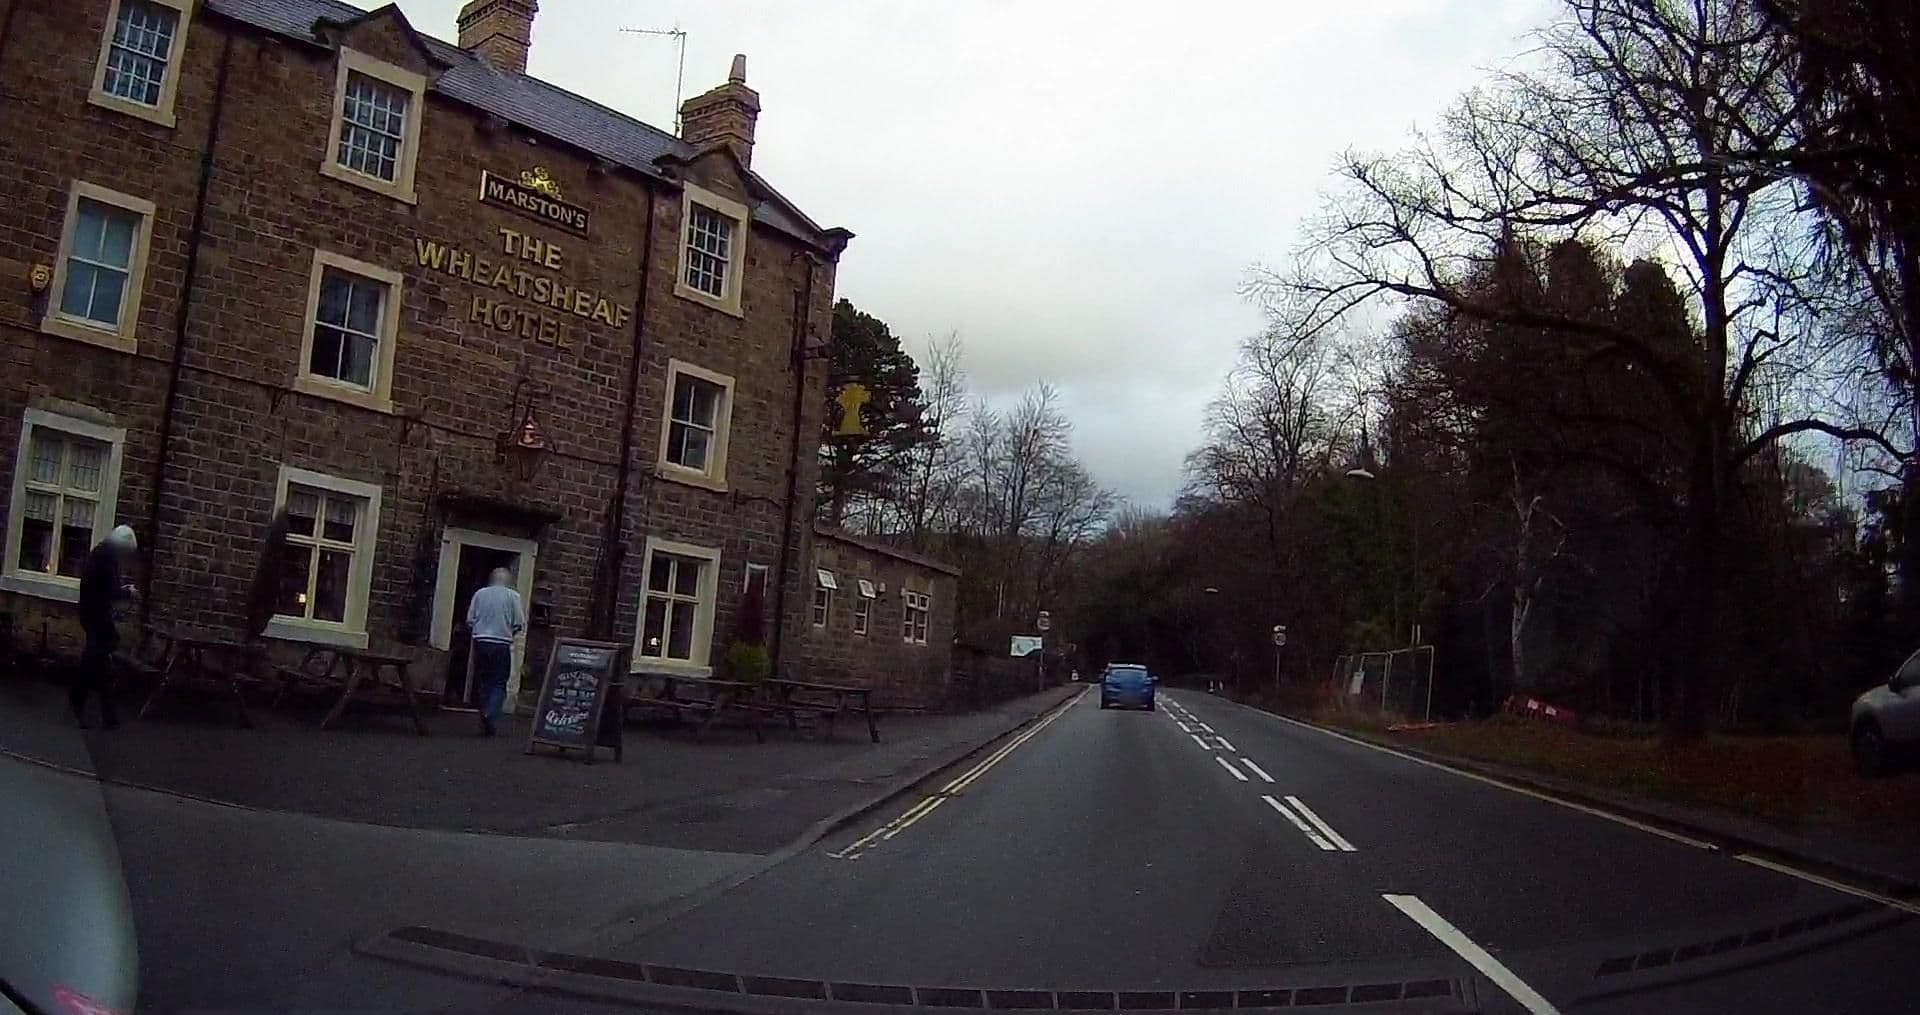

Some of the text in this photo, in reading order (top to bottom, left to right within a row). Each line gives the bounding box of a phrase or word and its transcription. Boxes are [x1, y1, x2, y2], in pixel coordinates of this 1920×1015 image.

[488, 181, 586, 229] MARSTON'S
[500, 227, 563, 270] THE
[416, 238, 631, 328] WHEATSHEAF
[471, 296, 575, 348] HOTEL
